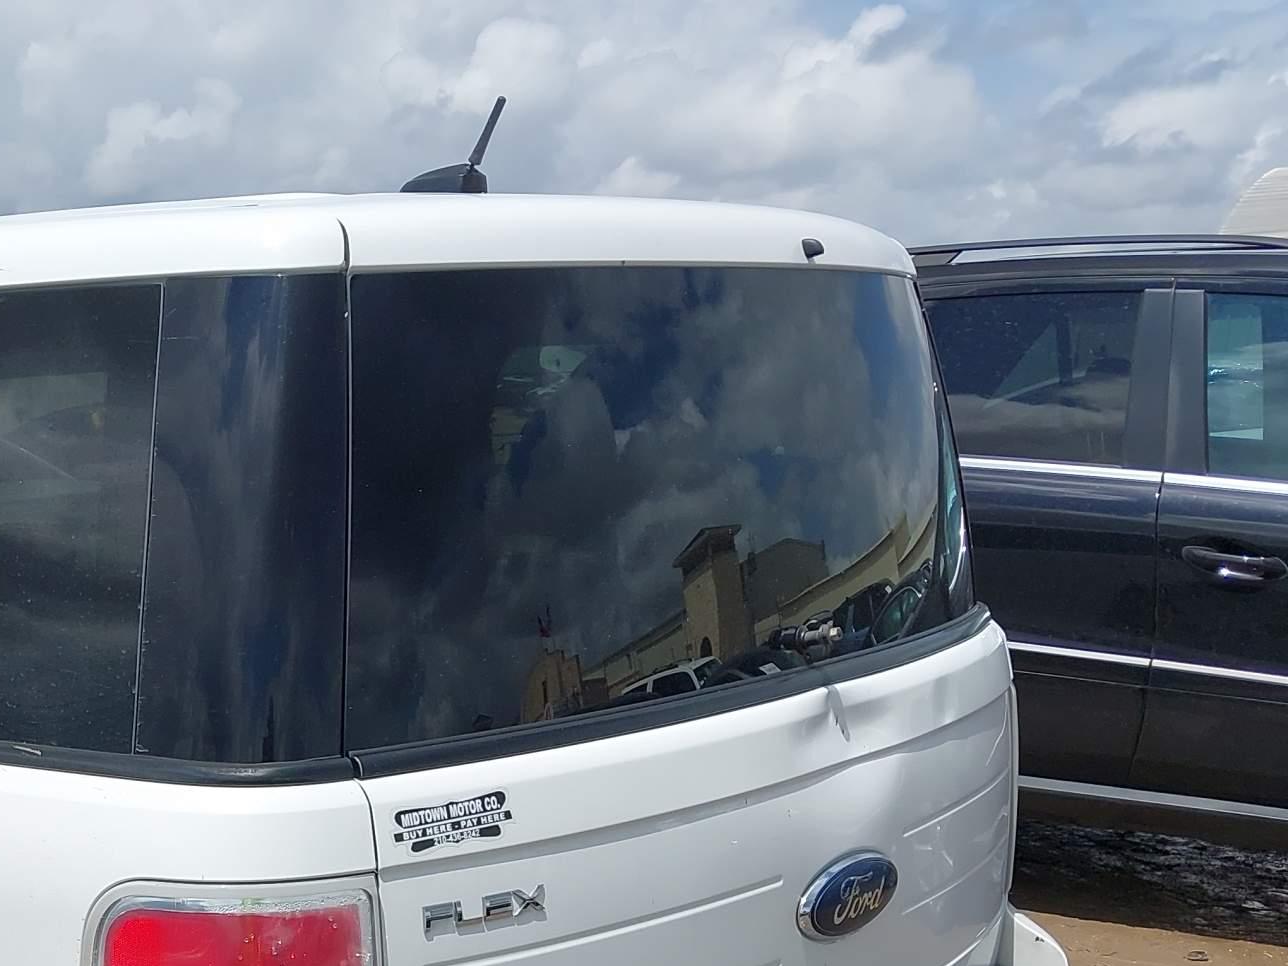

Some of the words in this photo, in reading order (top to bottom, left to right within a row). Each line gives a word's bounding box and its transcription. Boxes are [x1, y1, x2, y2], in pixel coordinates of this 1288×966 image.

[400, 806, 448, 828] MIDTOWN
[449, 799, 483, 818] MOTOR
[484, 795, 501, 811] CO.
[403, 829, 426, 840] BUY
[426, 823, 453, 836] HERE
[461, 817, 479, 829] PAY
[481, 812, 506, 824] HERE
[422, 884, 547, 942] FLEX
[834, 871, 886, 925] Ford
